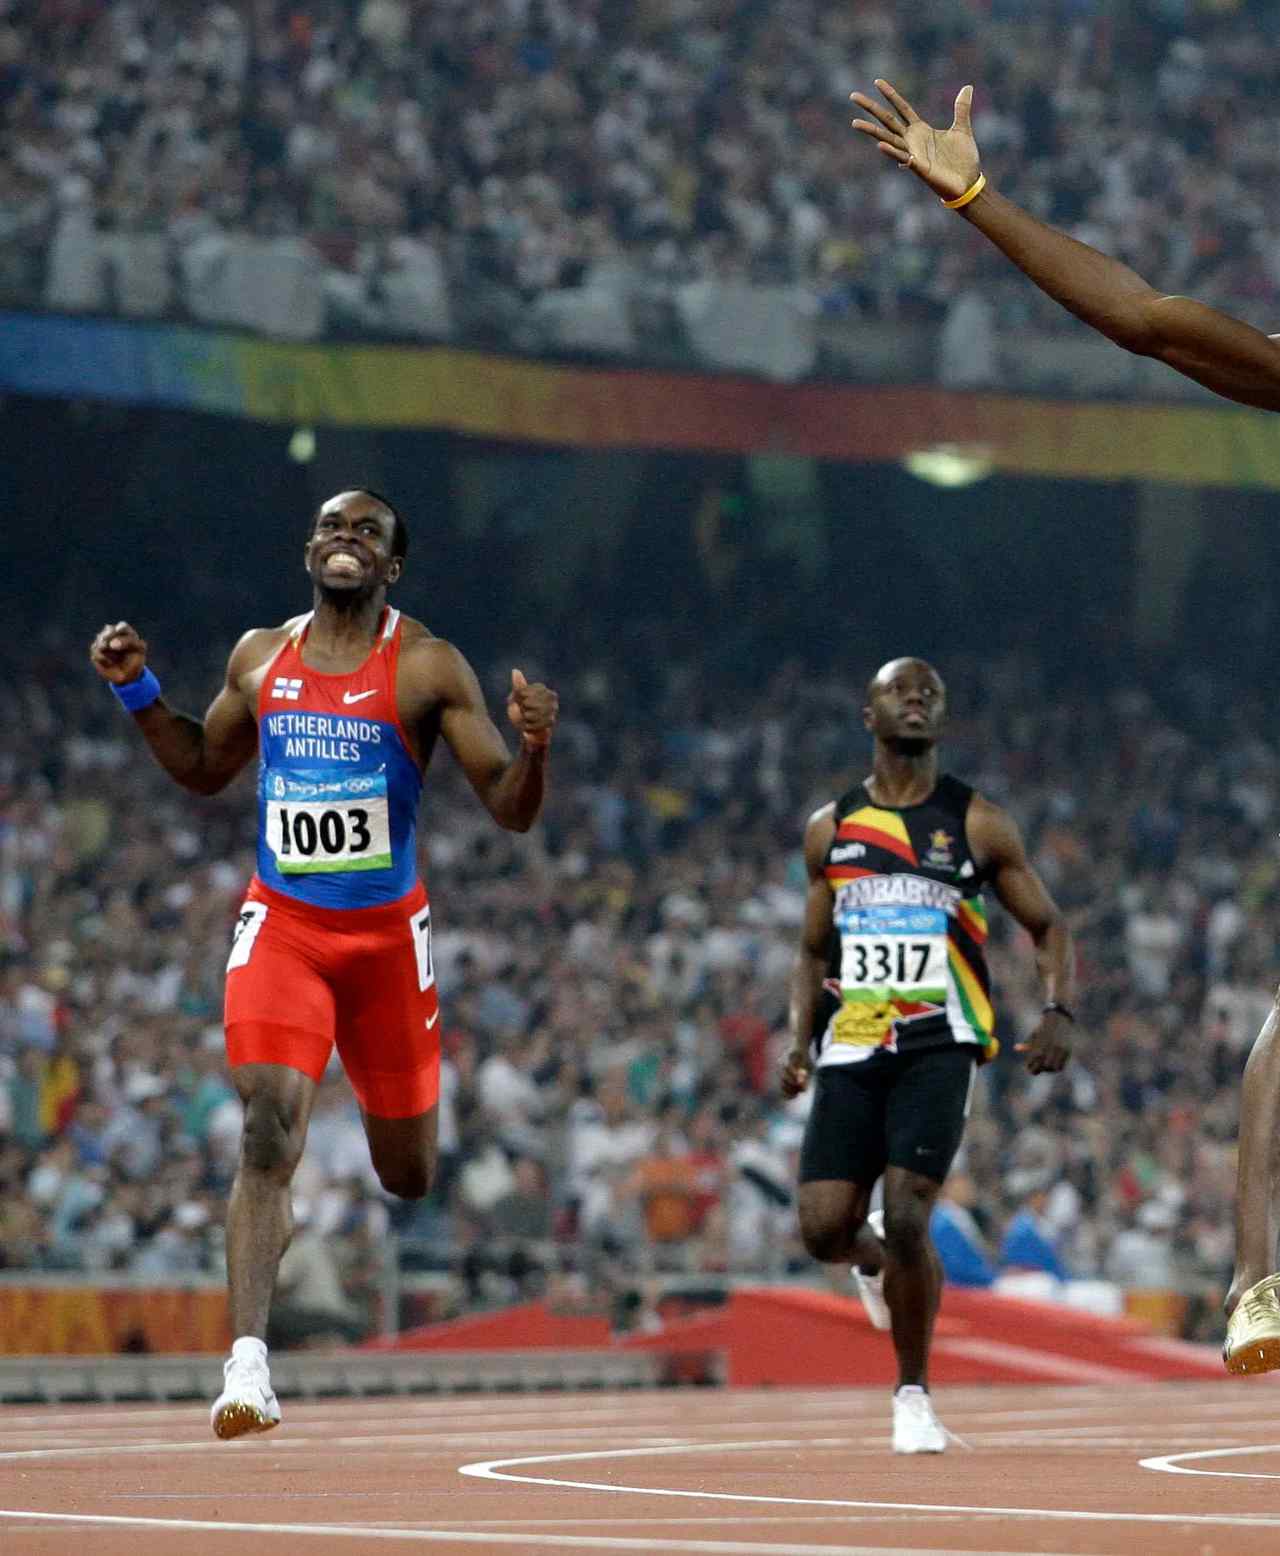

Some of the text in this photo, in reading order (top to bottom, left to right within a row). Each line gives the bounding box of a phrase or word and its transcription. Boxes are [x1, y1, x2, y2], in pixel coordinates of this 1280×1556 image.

[268, 714, 382, 744] NETHERLANDS
[285, 738, 361, 762] ANTILLES
[280, 808, 371, 856] 1003
[853, 942, 932, 983] 3317
